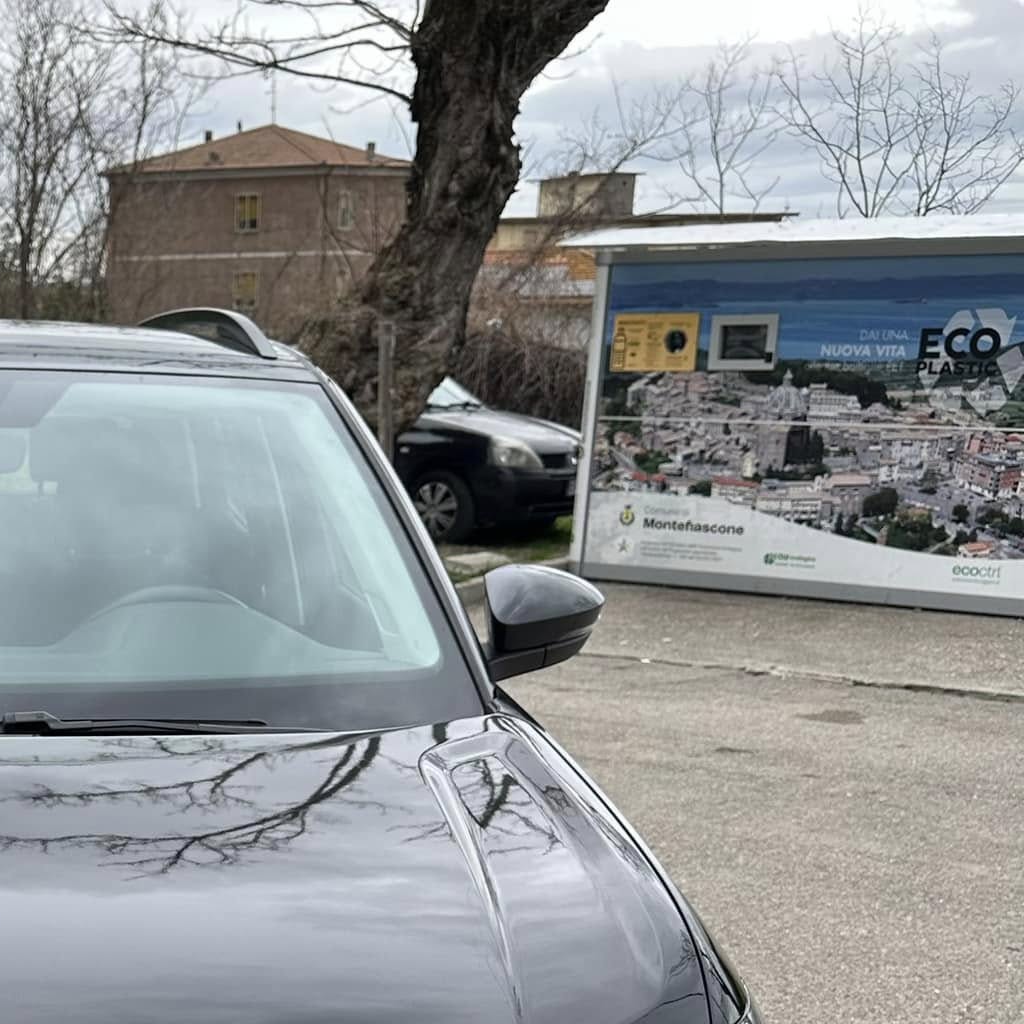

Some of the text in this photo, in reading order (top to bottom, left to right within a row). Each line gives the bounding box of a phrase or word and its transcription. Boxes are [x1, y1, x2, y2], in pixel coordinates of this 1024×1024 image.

[820, 344, 906, 358] NUOVA VITA
[918, 327, 1001, 360] ECO
[915, 360, 998, 376] PLASTIC
[642, 517, 745, 536] Montefiascone
[952, 564, 1001, 578] ecoctrl
